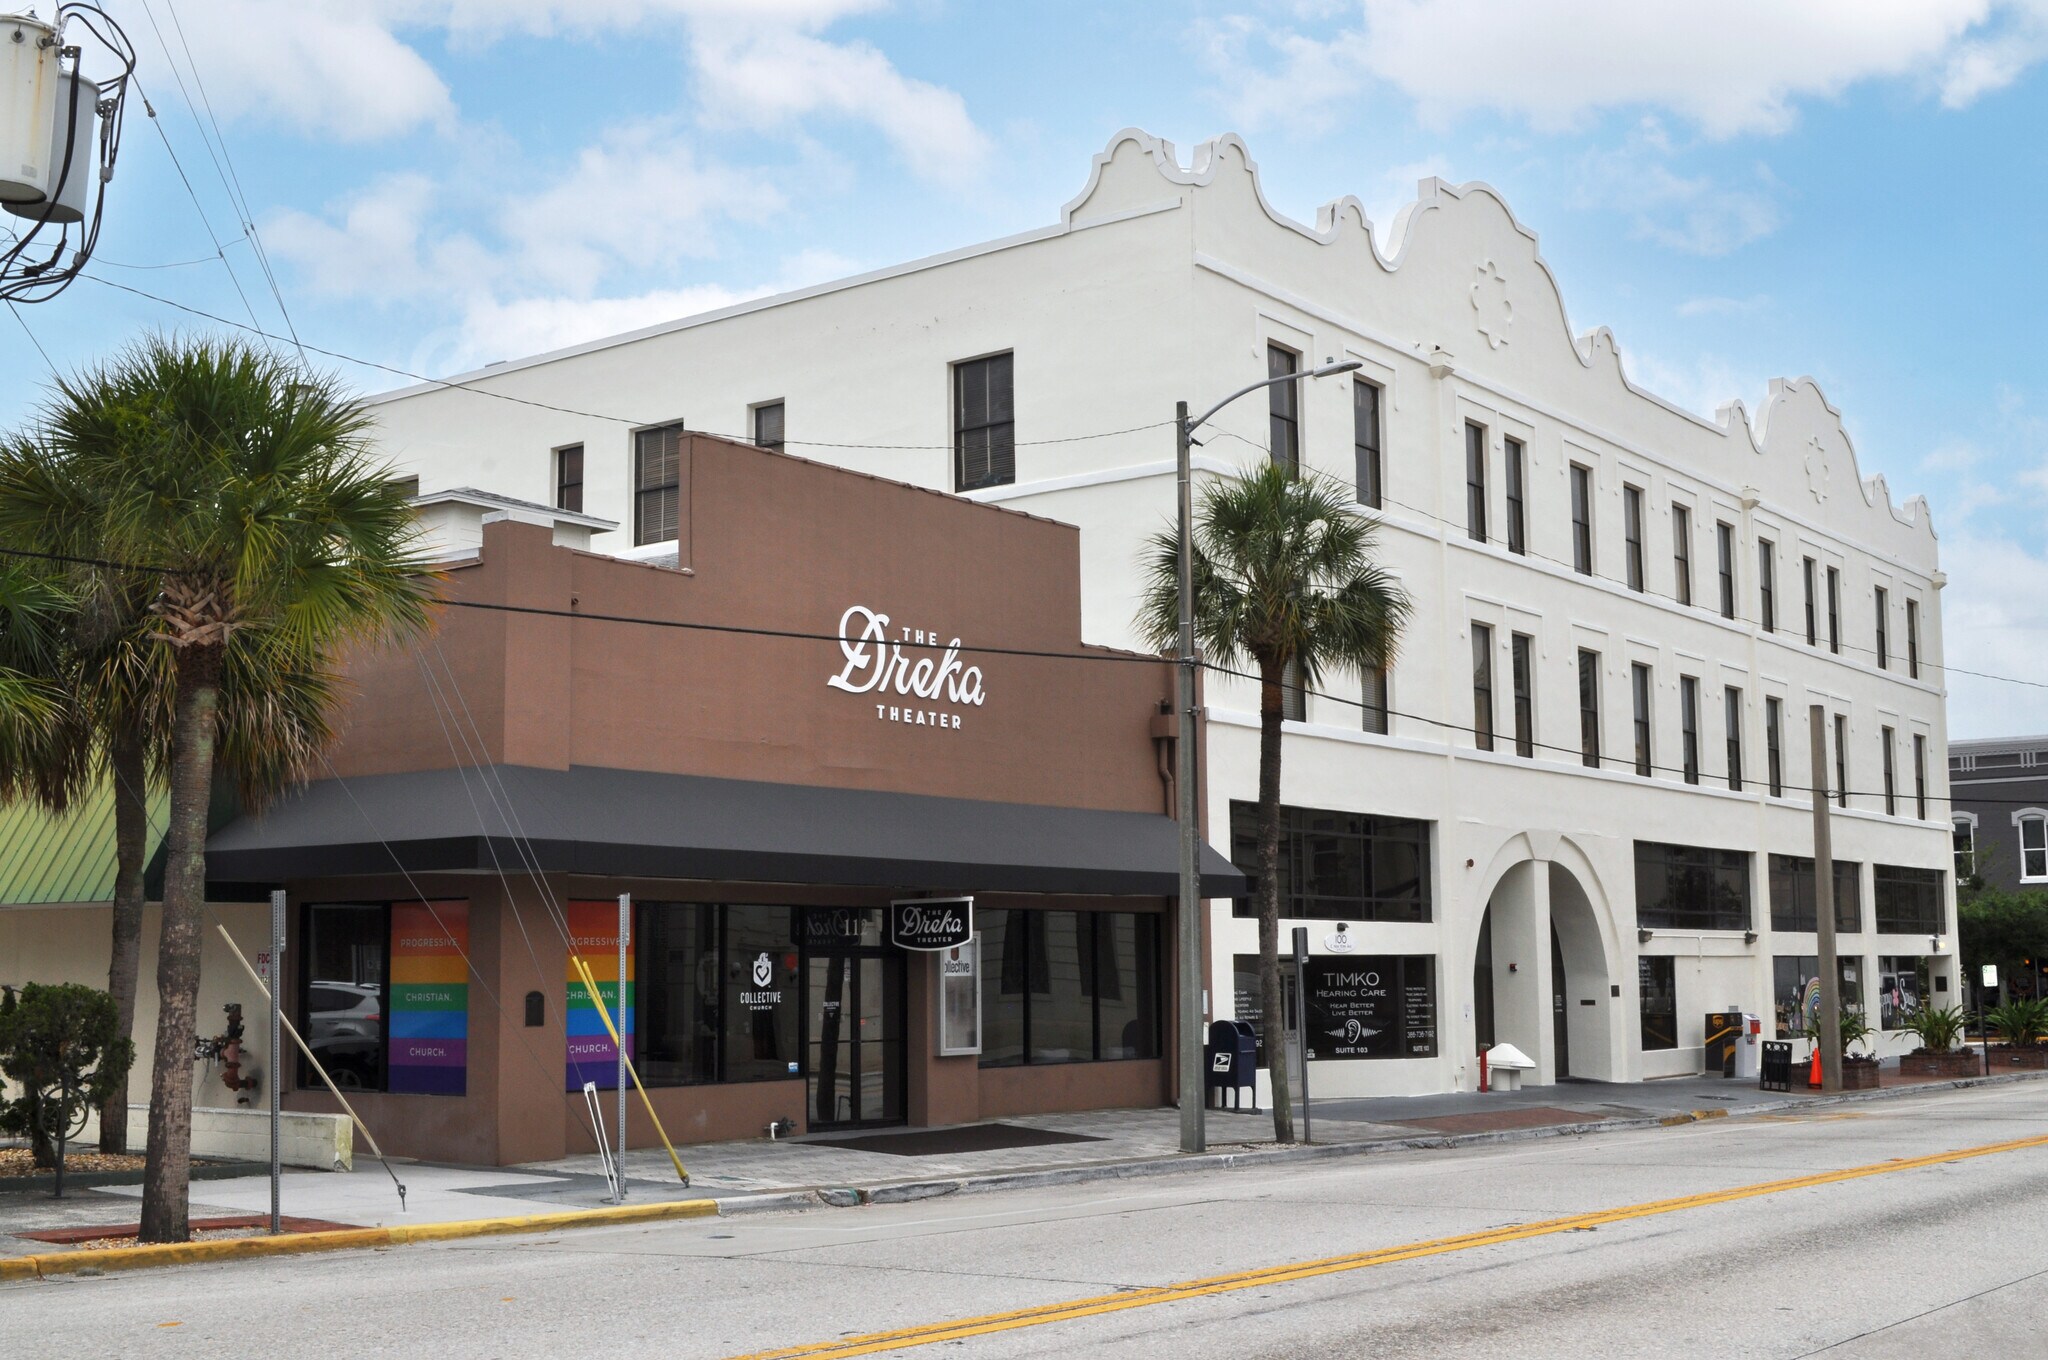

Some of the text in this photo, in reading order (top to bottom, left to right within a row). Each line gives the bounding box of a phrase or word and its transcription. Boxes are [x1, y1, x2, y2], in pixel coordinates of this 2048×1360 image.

[902, 627, 938, 646] THE
[827, 605, 986, 706] Dreka
[876, 704, 962, 730] THEATER
[844, 918, 868, 936] 112
[898, 906, 963, 936] Dreka
[400, 937, 460, 947] PROGRESSIVE.
[257, 953, 270, 964] FDC
[1322, 971, 1380, 987] TIMKO
[405, 992, 452, 1001] CHRISTIAN.
[740, 991, 782, 1004] COLLECTIVE
[1316, 988, 1387, 997] HEARING CARE
[409, 1047, 447, 1057] CHURCH.
[568, 1043, 611, 1054] CHURCH.
